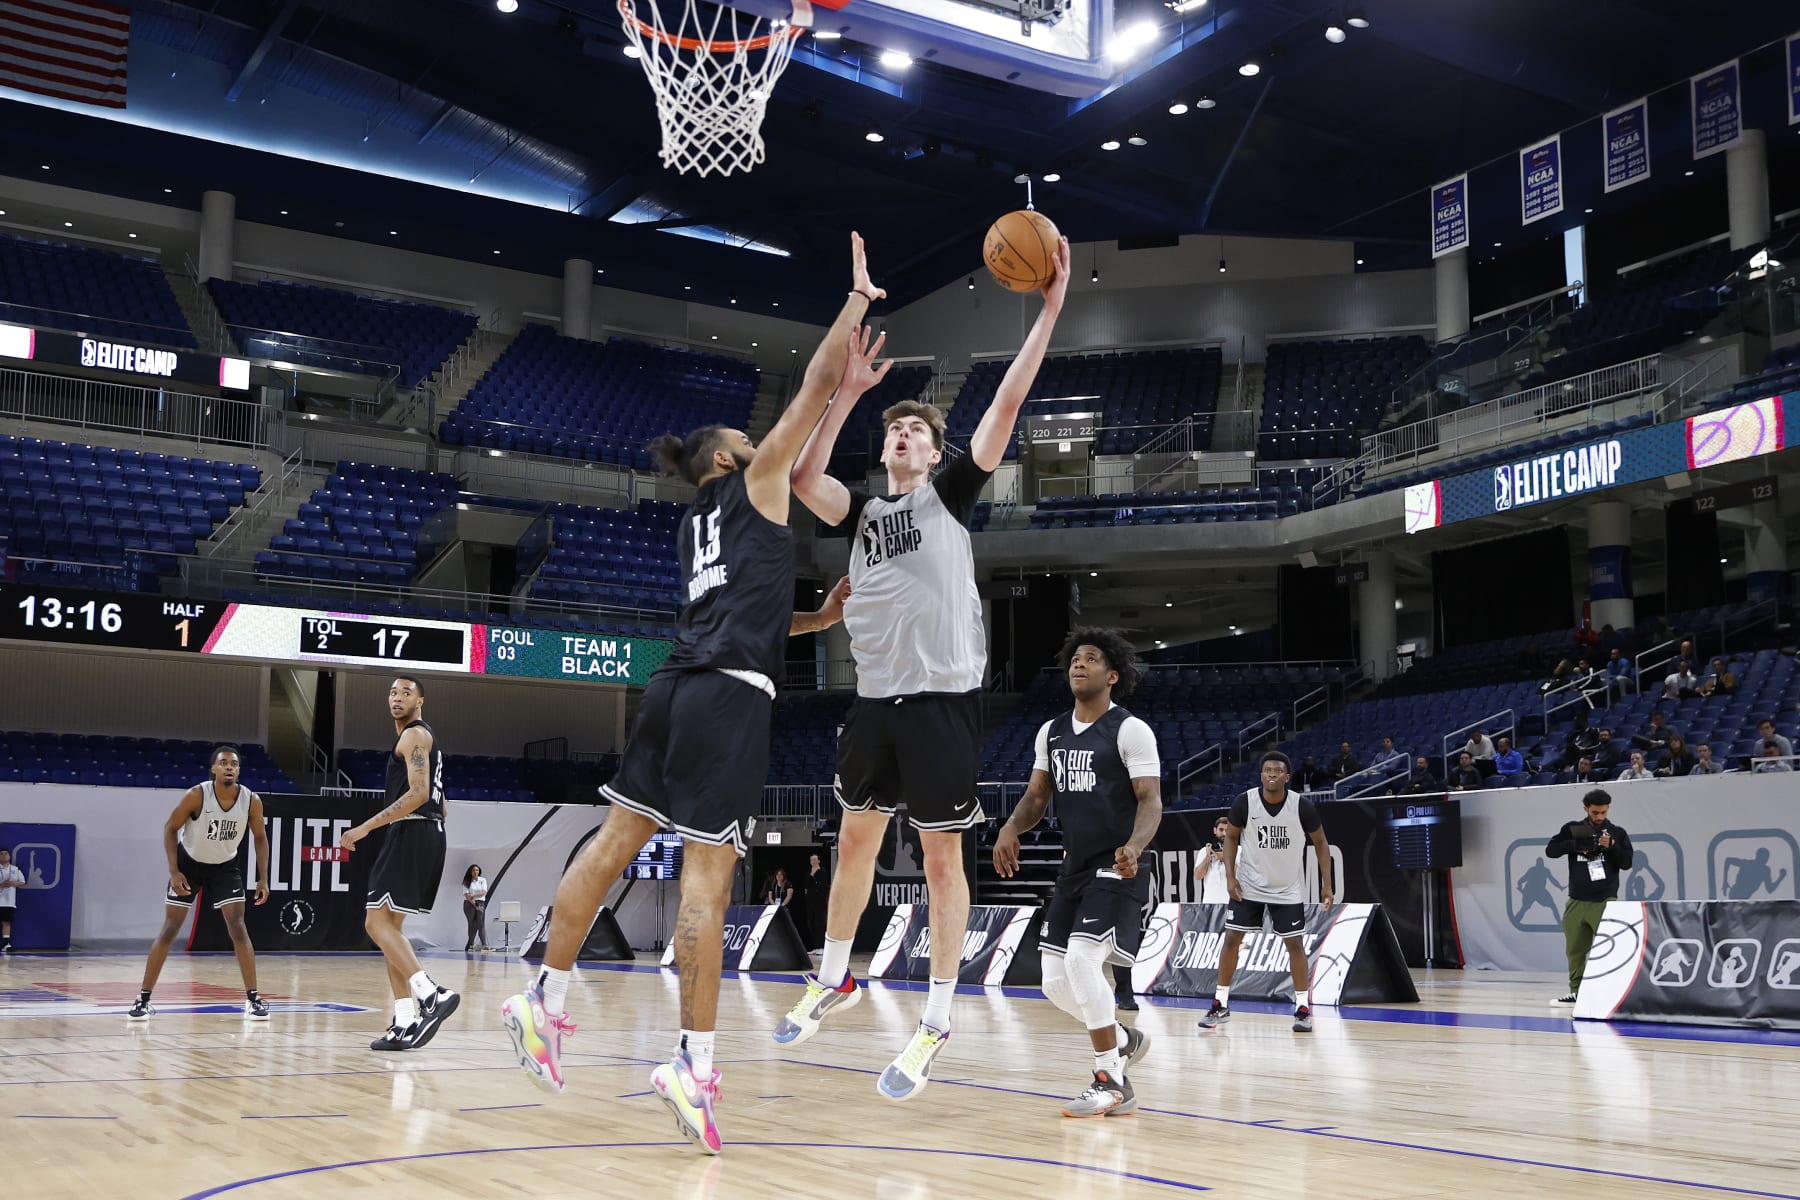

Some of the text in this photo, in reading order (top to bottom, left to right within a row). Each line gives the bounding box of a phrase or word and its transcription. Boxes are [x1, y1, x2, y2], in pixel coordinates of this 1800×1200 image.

[1610, 132, 1640, 151] NCAA
[1527, 167, 1554, 186] NCAA
[1437, 204, 1461, 221] NCAA
[97, 341, 177, 377] ELITE CAMP
[1032, 429, 1050, 438] 220
[1057, 428, 1072, 437] 221
[1514, 440, 1621, 505] ELITE CAMP
[1696, 484, 1772, 511] 122 123
[882, 509, 915, 537] ELITE
[885, 529, 922, 559] CAMP
[1011, 586, 1026, 596] 121
[18, 595, 122, 633] 13:16
[163, 602, 205, 617] HALF
[175, 618, 190, 647] 1
[306, 618, 342, 636] TOL
[317, 635, 328, 649] 2
[372, 628, 410, 657] 17
[491, 629, 535, 646] FOUL
[497, 646, 516, 661] 03
[561, 636, 631, 659] TEAM 1
[561, 656, 631, 678] BLACK
[1067, 750, 1095, 770] ELITE
[1067, 770, 1096, 792] CAMP
[221, 820, 238, 831] ELITE
[1270, 826, 1288, 837] ELITE
[219, 830, 238, 841] CAMP
[1270, 838, 1290, 849] CAMP
[246, 817, 352, 892] ELITE
[310, 847, 341, 860] CAMP
